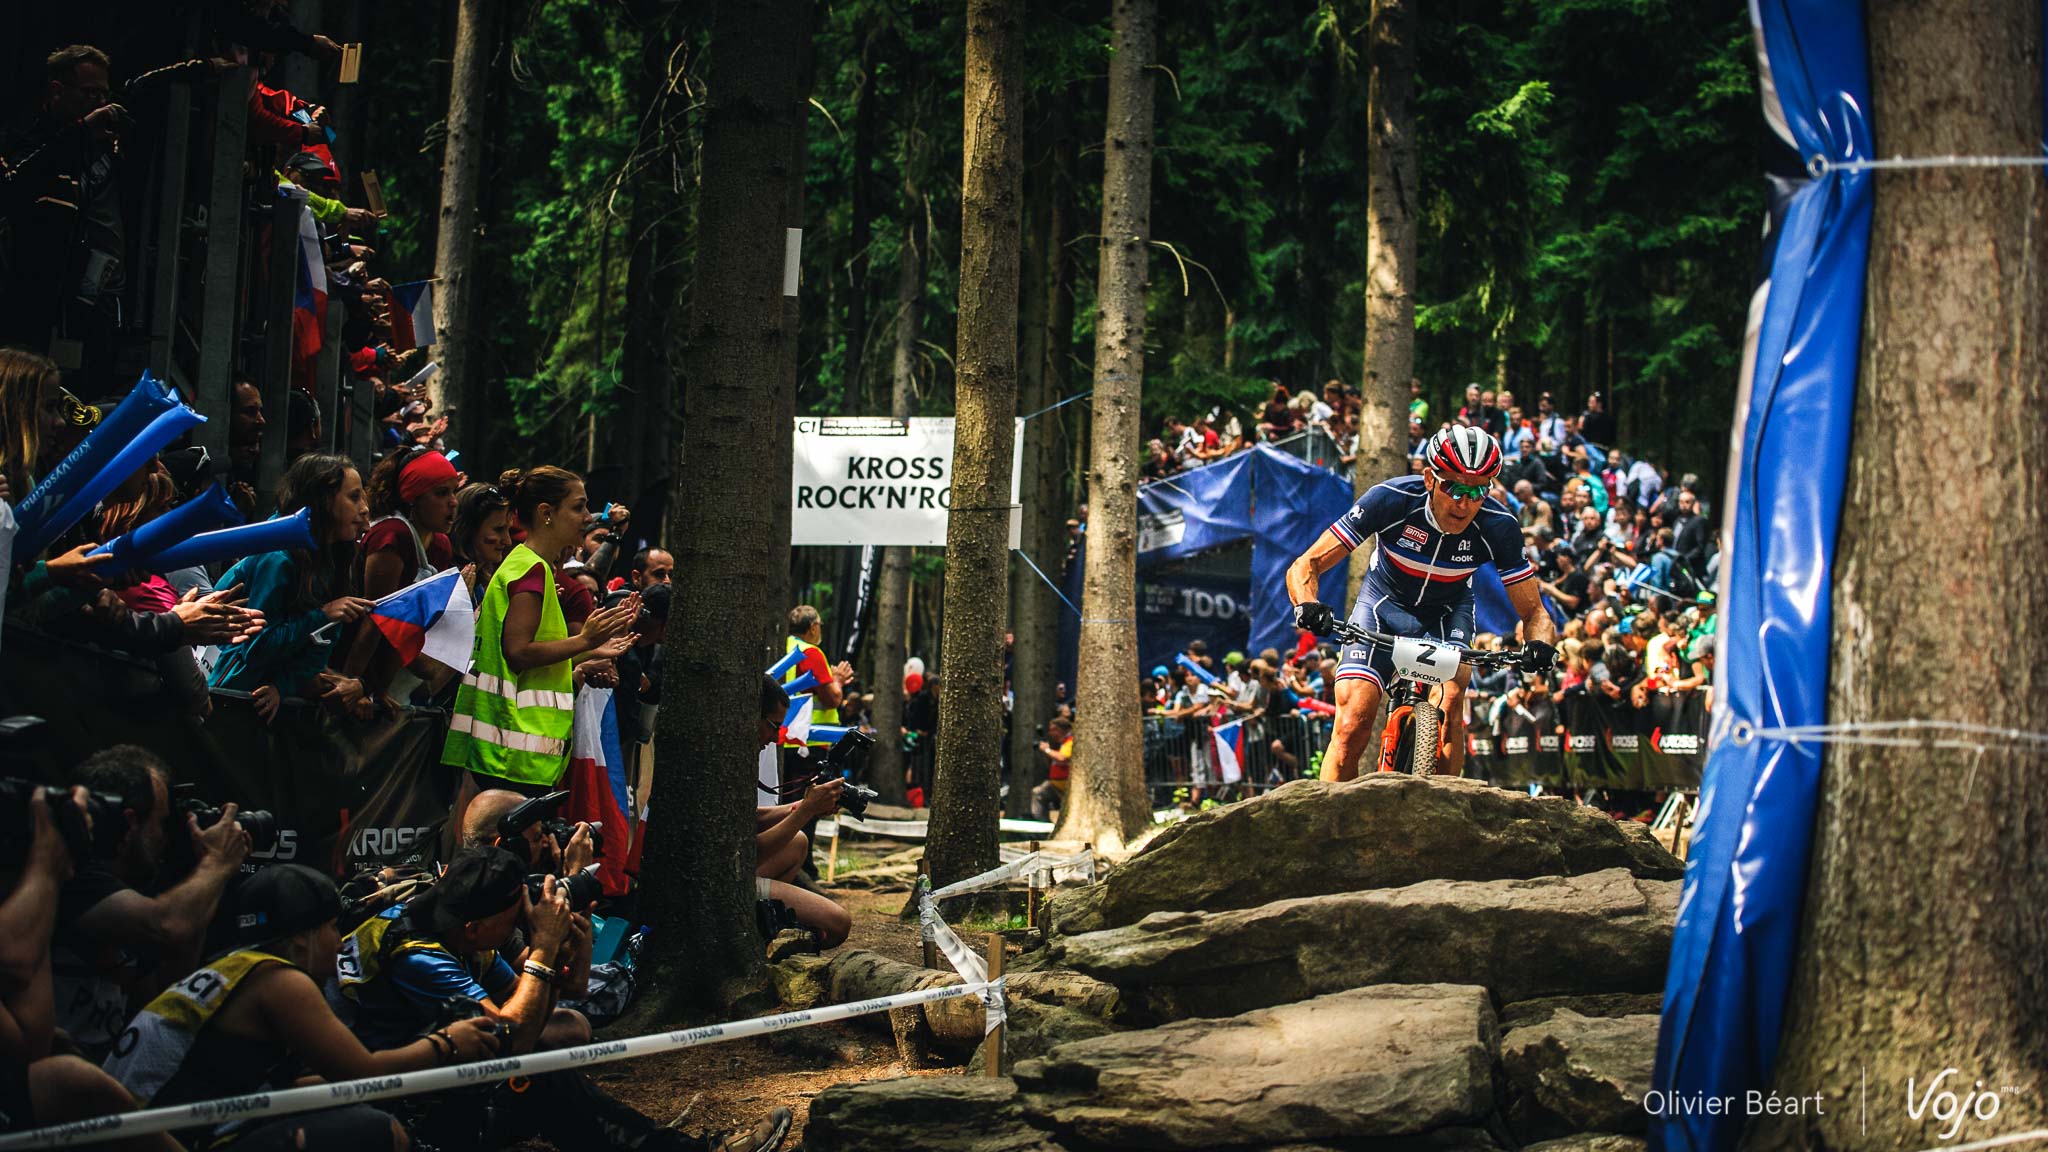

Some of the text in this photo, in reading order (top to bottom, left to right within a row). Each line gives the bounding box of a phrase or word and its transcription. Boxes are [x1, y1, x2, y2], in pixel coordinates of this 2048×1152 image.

[793, 420, 817, 434] CI
[847, 456, 944, 479] KROSS
[1415, 643, 1437, 667] 2
[1410, 671, 1442, 684] ŠKODA
